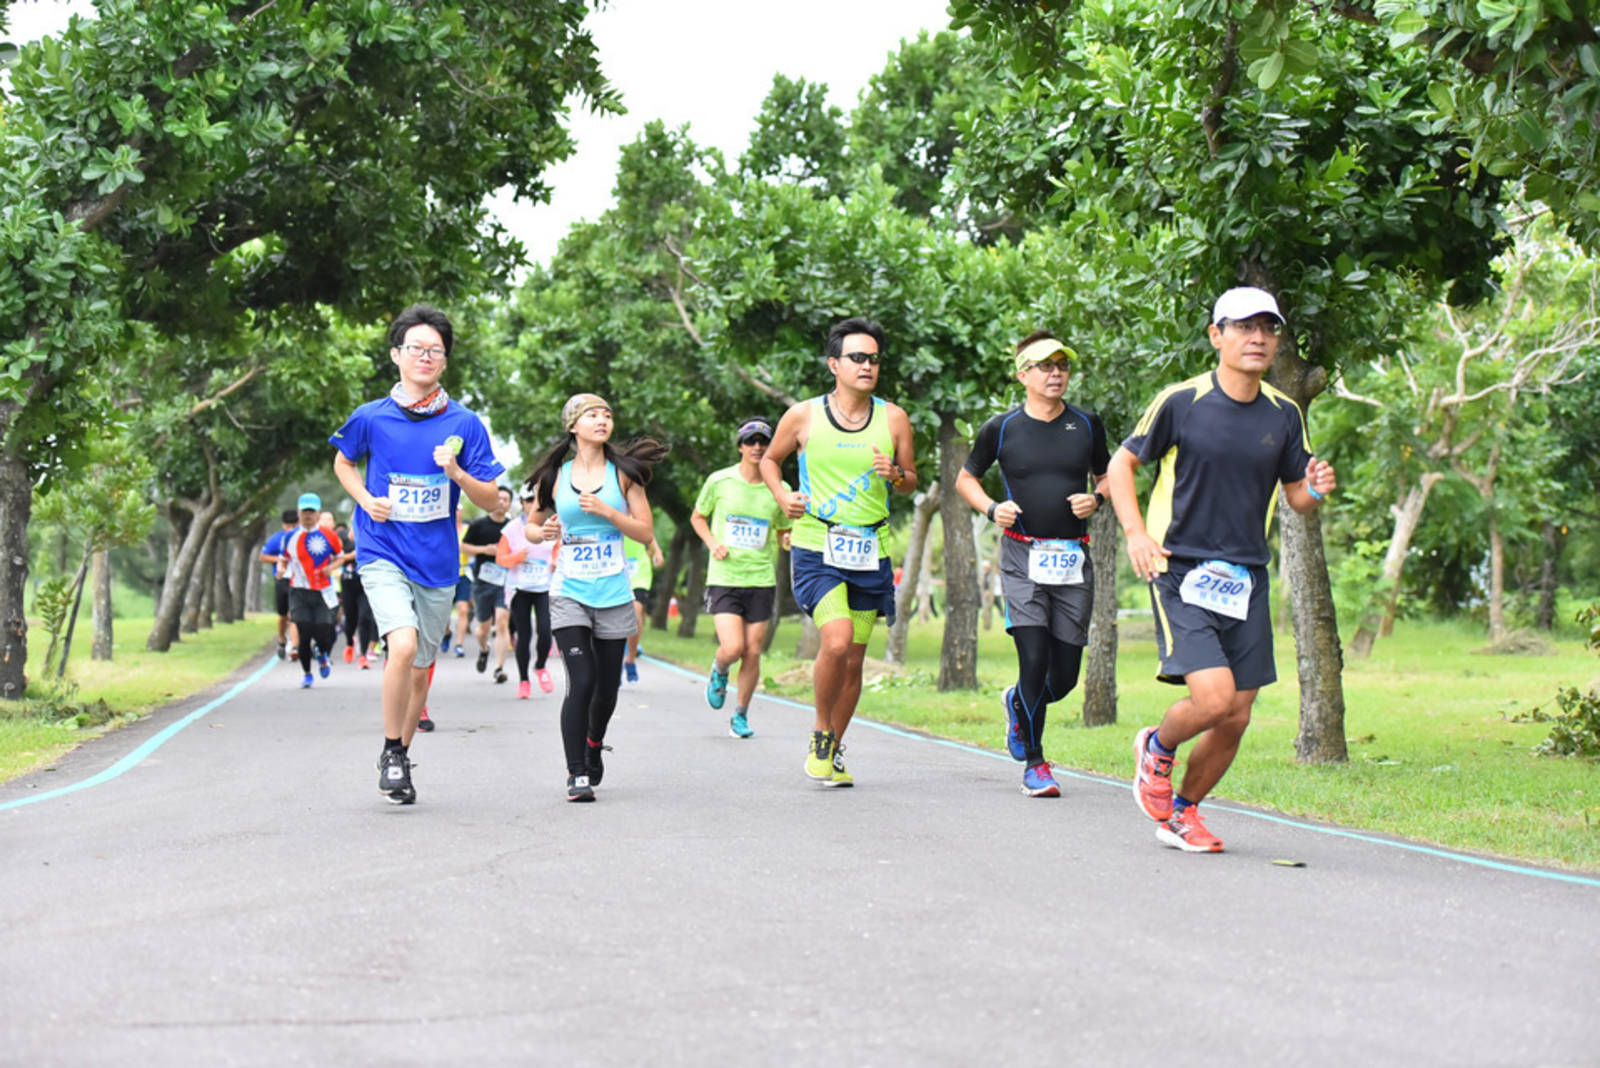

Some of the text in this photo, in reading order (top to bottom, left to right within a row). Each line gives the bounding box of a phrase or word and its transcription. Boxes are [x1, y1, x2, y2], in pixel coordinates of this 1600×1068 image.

[398, 488, 441, 505] 2129
[731, 524, 761, 537] 2114
[573, 544, 613, 562] 2214
[834, 537, 873, 555] 2116
[1039, 553, 1078, 569] 2159
[1194, 574, 1245, 596] 2180
